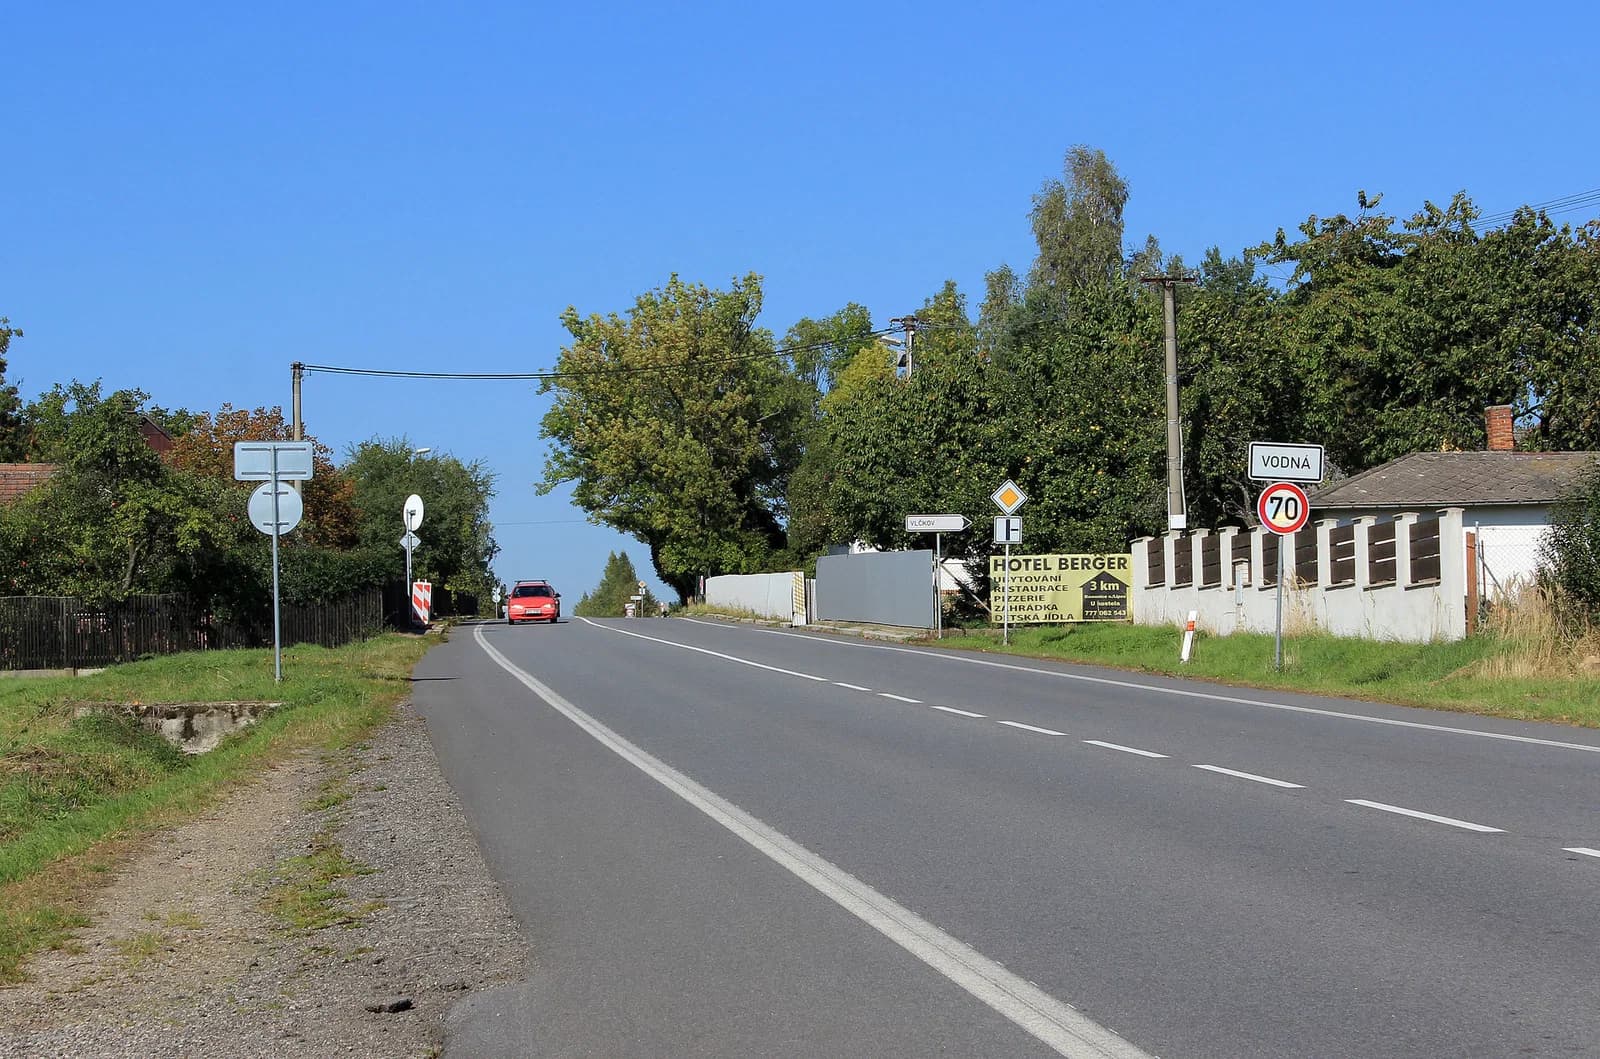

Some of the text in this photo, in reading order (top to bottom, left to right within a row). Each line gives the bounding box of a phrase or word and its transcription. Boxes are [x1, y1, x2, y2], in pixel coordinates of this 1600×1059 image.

[1261, 454, 1311, 469] VODNÁ
[1269, 496, 1298, 520] 70
[993, 557, 1128, 572] HOTEL BERGER
[1090, 580, 1120, 591] 3 km
